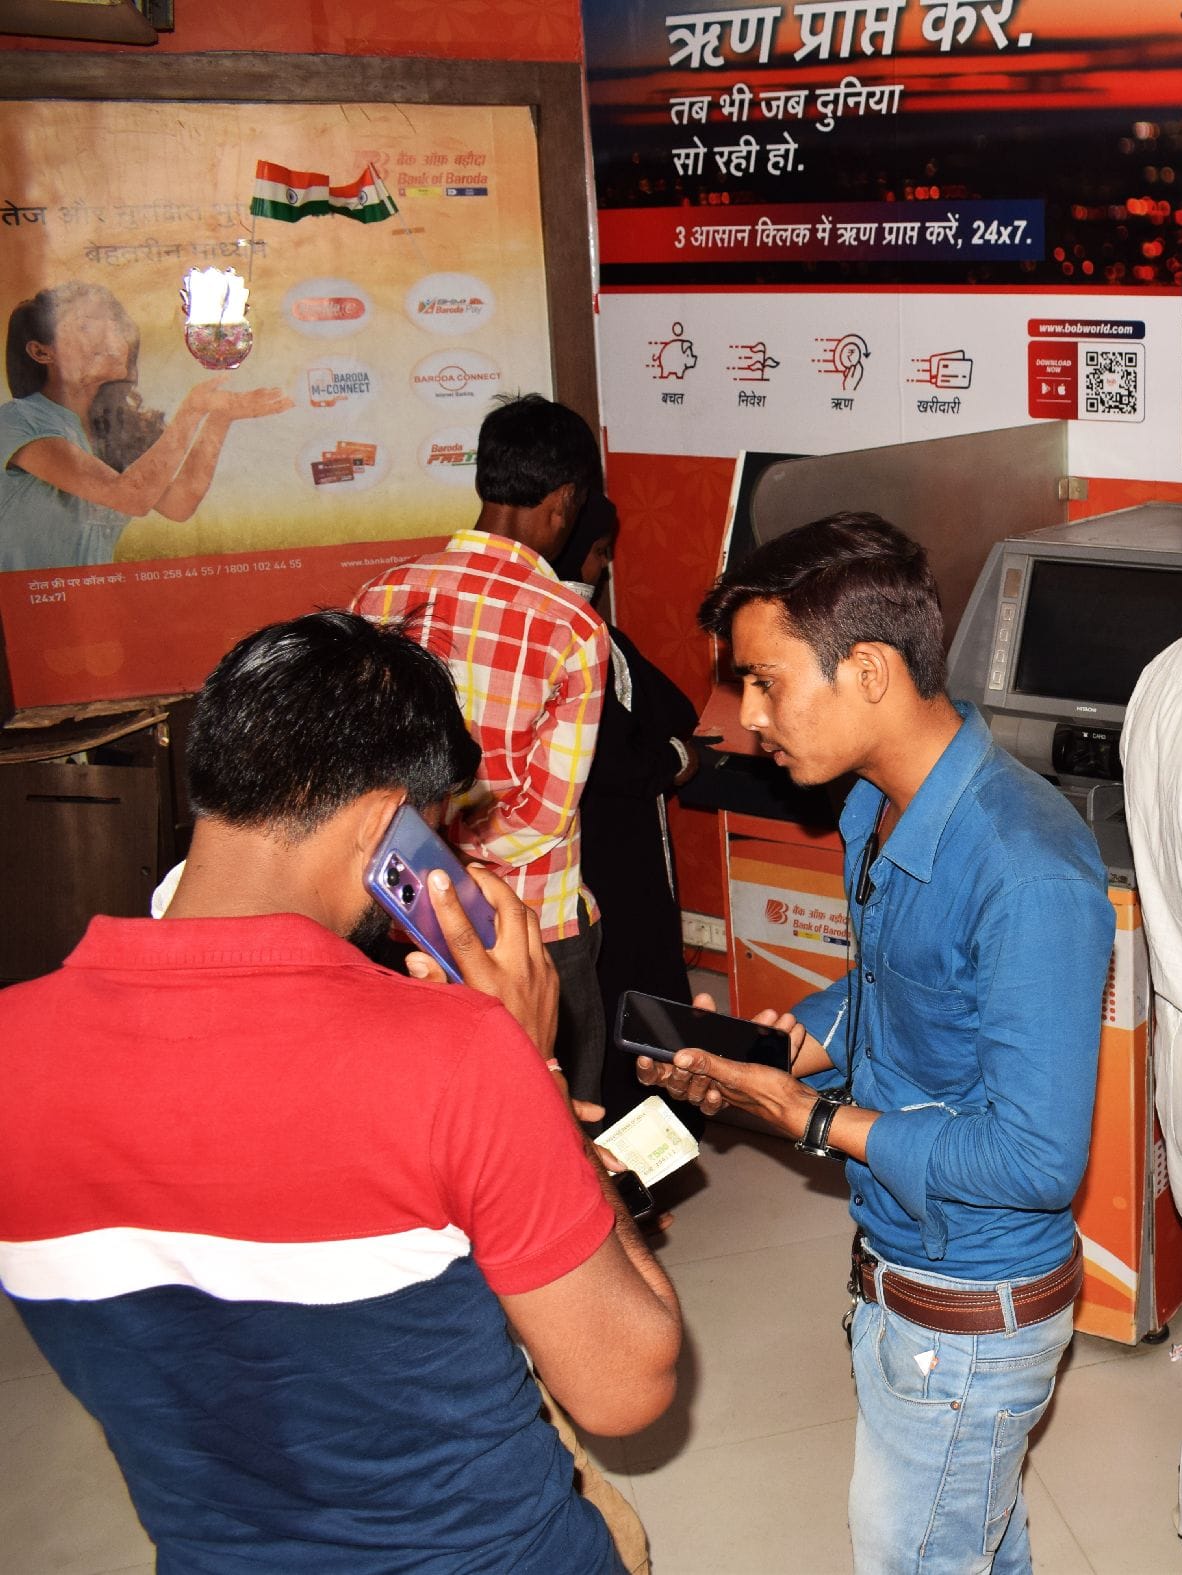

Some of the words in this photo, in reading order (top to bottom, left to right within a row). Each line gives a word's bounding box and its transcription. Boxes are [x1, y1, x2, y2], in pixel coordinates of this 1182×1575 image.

[665, 7, 781, 68] ऋण
[793, 0, 906, 61] प्राप्त
[670, 96, 711, 125] तब
[720, 83, 752, 122] भी
[760, 90, 809, 119] जब
[816, 76, 904, 132] दुनिया
[672, 137, 706, 176] सो
[714, 134, 759, 176] रही
[767, 132, 805, 173] हो.
[398, 172, 428, 185] Bank
[432, 173, 443, 185] of
[446, 172, 488, 184] Baroda
[675, 226, 685, 248] 3
[690, 225, 751, 247] आसान
[755, 217, 811, 246] क्लिक
[816, 215, 833, 245] में
[837, 223, 876, 245] ऋण
[882, 222, 921, 245] प्राप्त
[925, 213, 963, 249] करें,
[971, 220, 1032, 244] 24x7.
[1039, 323, 1133, 334] www.bobworld.com
[1036, 359, 1072, 367] DOWNLOAD
[334, 372, 370, 383] BARODA
[414, 374, 454, 383] BARODA
[457, 372, 502, 382] CONNECT
[311, 383, 370, 396] M-CONNECT
[661, 392, 684, 406] बचत
[738, 390, 767, 408] निवेश
[831, 397, 855, 411] ऋण
[917, 396, 961, 414] खरीदारी
[431, 443, 463, 452] Baroda
[28, 580, 49, 590] टोल
[83, 575, 105, 586] कॉल
[134, 571, 160, 582] 1800
[185, 567, 198, 577] 44
[201, 566, 214, 577] 55
[224, 563, 250, 575] 1800
[253, 562, 271, 572] 102
[273, 560, 287, 570] 44
[289, 559, 302, 569] 55
[793, 920, 814, 931] Bank
